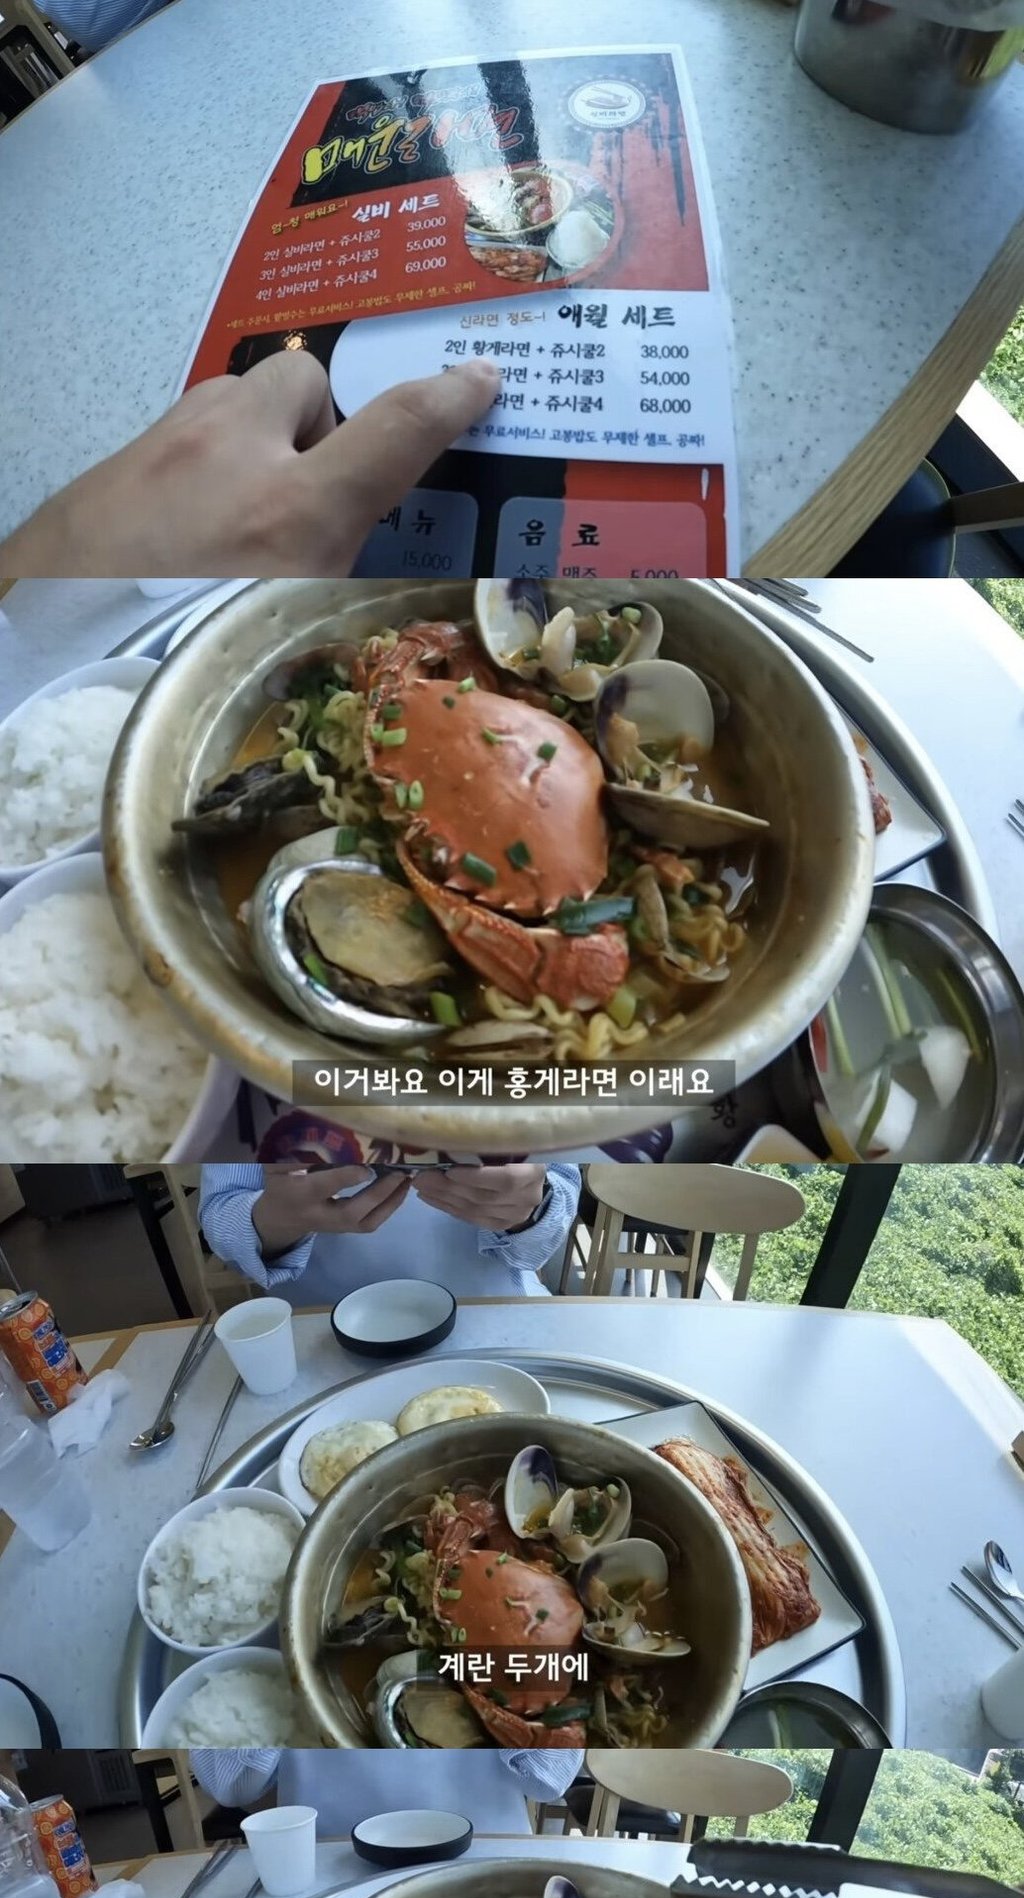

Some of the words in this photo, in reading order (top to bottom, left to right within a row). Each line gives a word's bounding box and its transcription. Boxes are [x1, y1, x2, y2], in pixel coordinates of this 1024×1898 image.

[352, 200, 390, 224] 실비
[399, 193, 440, 214] 세트
[406, 216, 447, 232] 39,000
[263, 249, 280, 262] 2인
[284, 239, 325, 260] 실비라면
[339, 228, 381, 246] 쥬시쿨2
[405, 236, 447, 253] 55,000
[259, 268, 276, 281] 3인
[279, 258, 322, 279] 실비라면
[335, 248, 380, 267] 쥬시쿨3
[404, 256, 447, 274] 69,000
[256, 288, 273, 301] 4인
[275, 278, 319, 298] 실비라면
[333, 268, 378, 288] 쥬시쿨4
[459, 313, 499, 330] 신라면
[557, 303, 608, 329] 애월
[621, 306, 676, 330] 세트
[444, 339, 467, 356] 2인
[471, 340, 531, 358] 황게라면
[550, 343, 606, 359] 쥬시쿨2
[640, 344, 690, 361] 38,000
[547, 368, 605, 386] 쥬시쿨3
[640, 370, 690, 387] 54,000
[544, 394, 604, 413] 쥬시쿨4
[639, 398, 692, 415] 68,000
[549, 428, 598, 443] 고봉밥도
